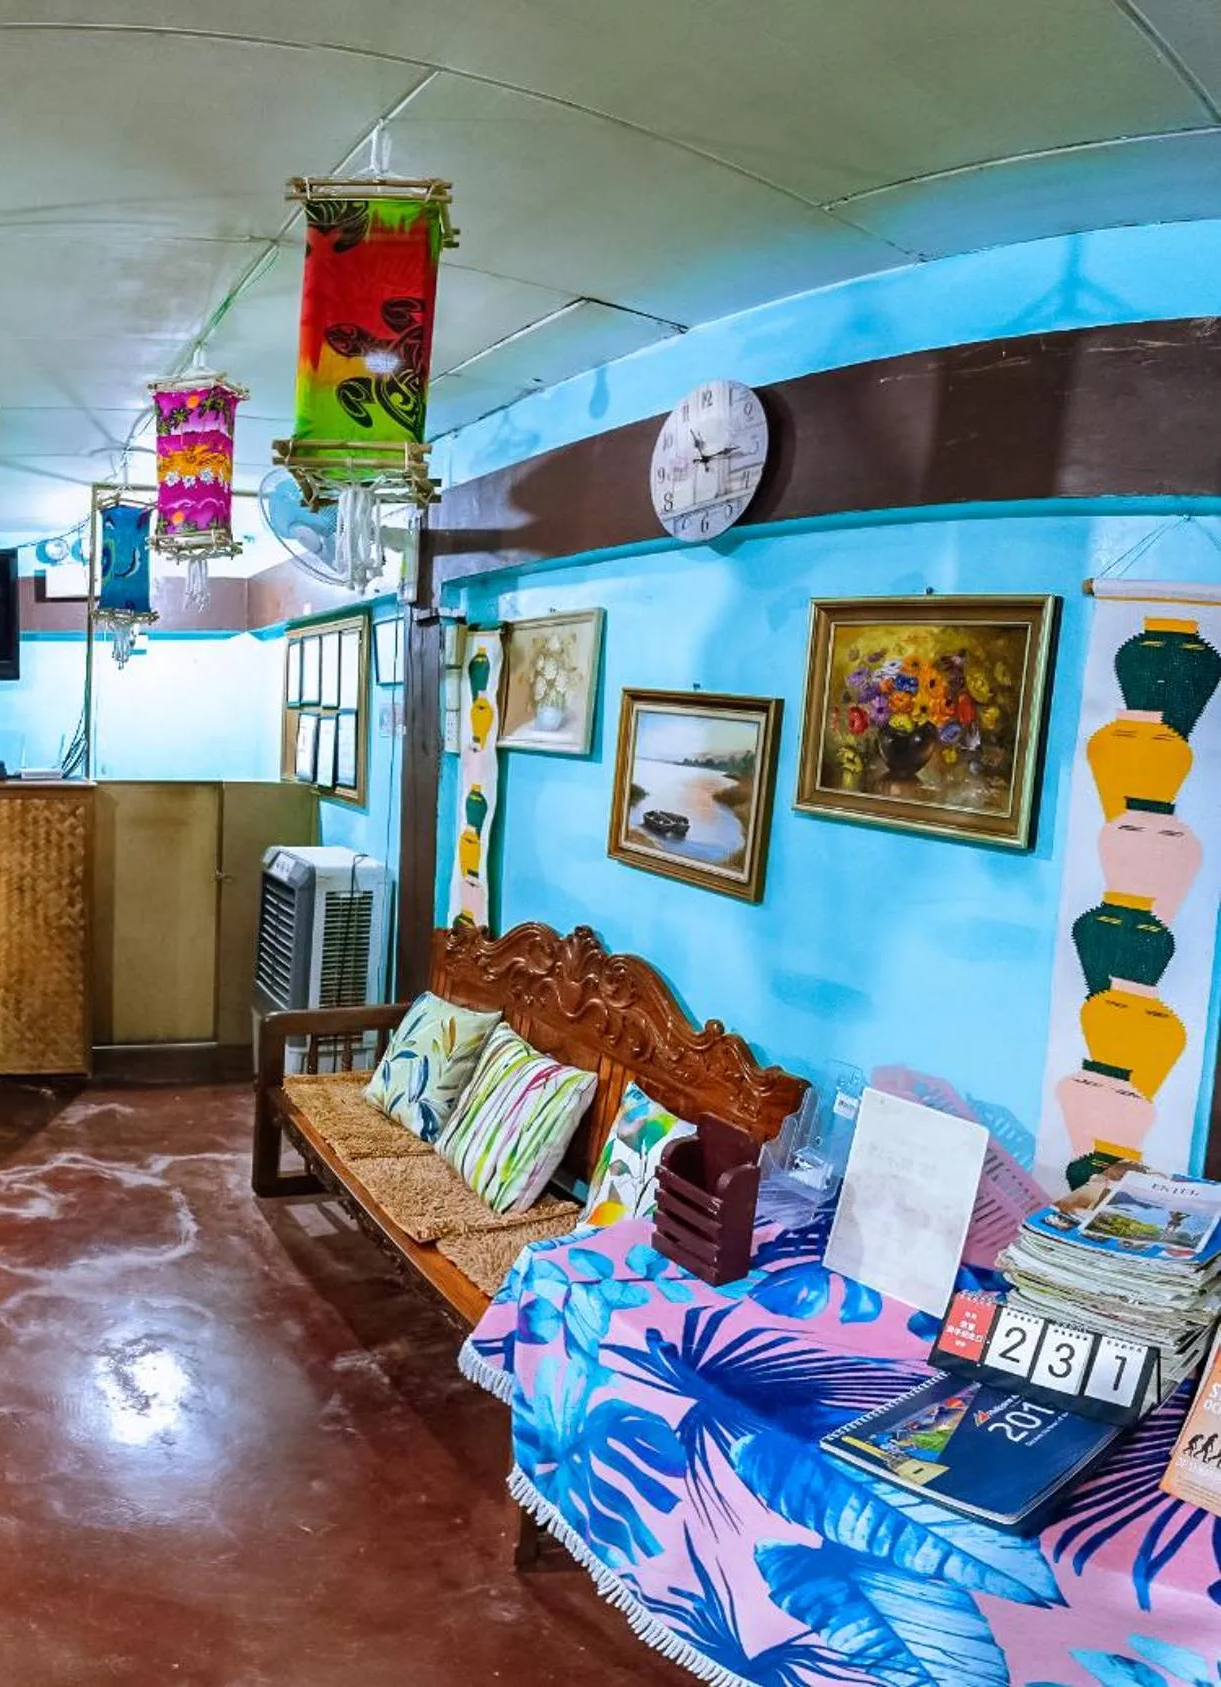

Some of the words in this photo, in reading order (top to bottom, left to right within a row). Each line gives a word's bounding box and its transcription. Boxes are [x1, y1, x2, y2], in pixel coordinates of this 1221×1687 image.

[702, 391, 713, 407] 12
[682, 405, 690, 422] 11
[657, 468, 666, 484] 9
[663, 492, 675, 513] 8
[701, 515, 710, 533] 6
[998, 1326, 1028, 1364] 2
[1047, 1342, 1076, 1379] 3
[1112, 1355, 1127, 1391] 1
[988, 1402, 1055, 1442] 201
